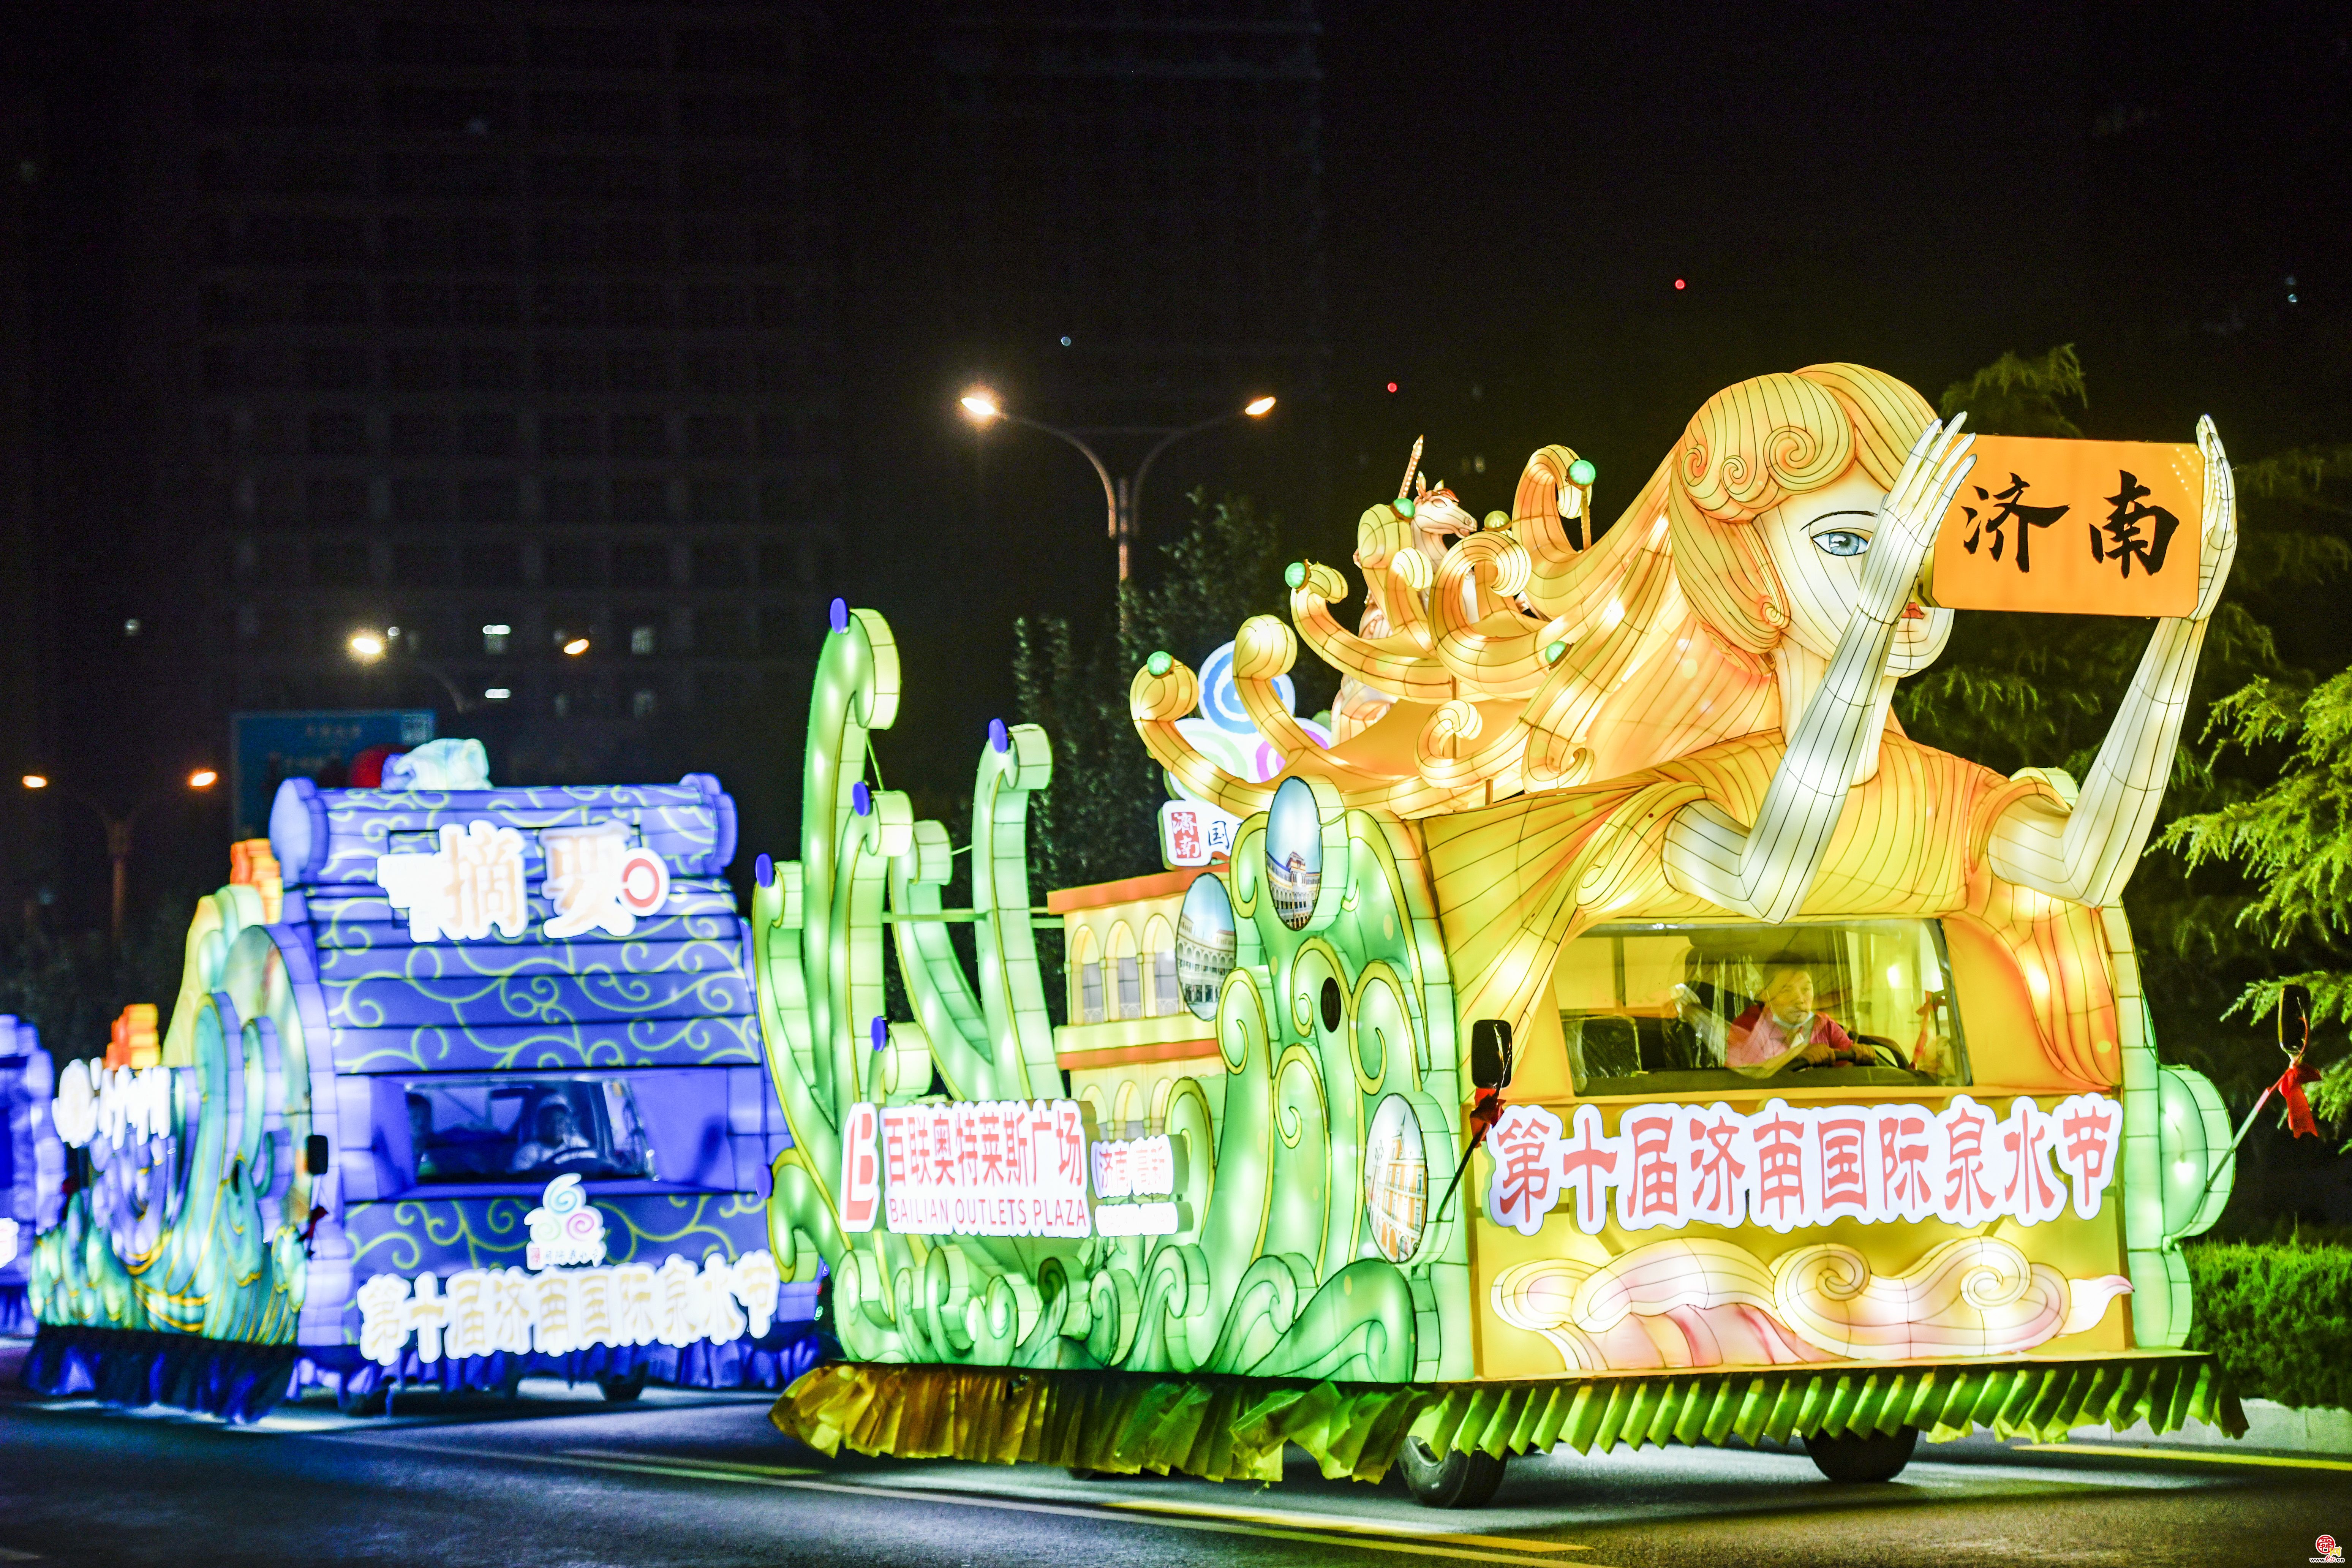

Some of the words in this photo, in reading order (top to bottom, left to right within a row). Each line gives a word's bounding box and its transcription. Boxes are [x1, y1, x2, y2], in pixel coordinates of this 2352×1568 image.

[1961, 470, 2180, 579] 济南
[1171, 812, 1201, 858] 濟南
[1208, 821, 1242, 849] 国
[884, 1110, 1083, 1187] 百联奥特莱斯广场
[1497, 1106, 2113, 1223] 第十届济南国际泉水节
[891, 1198, 949, 1225] BAILIAN
[955, 1198, 1026, 1226] OUTLETS
[1034, 1199, 1087, 1228] PLAZA
